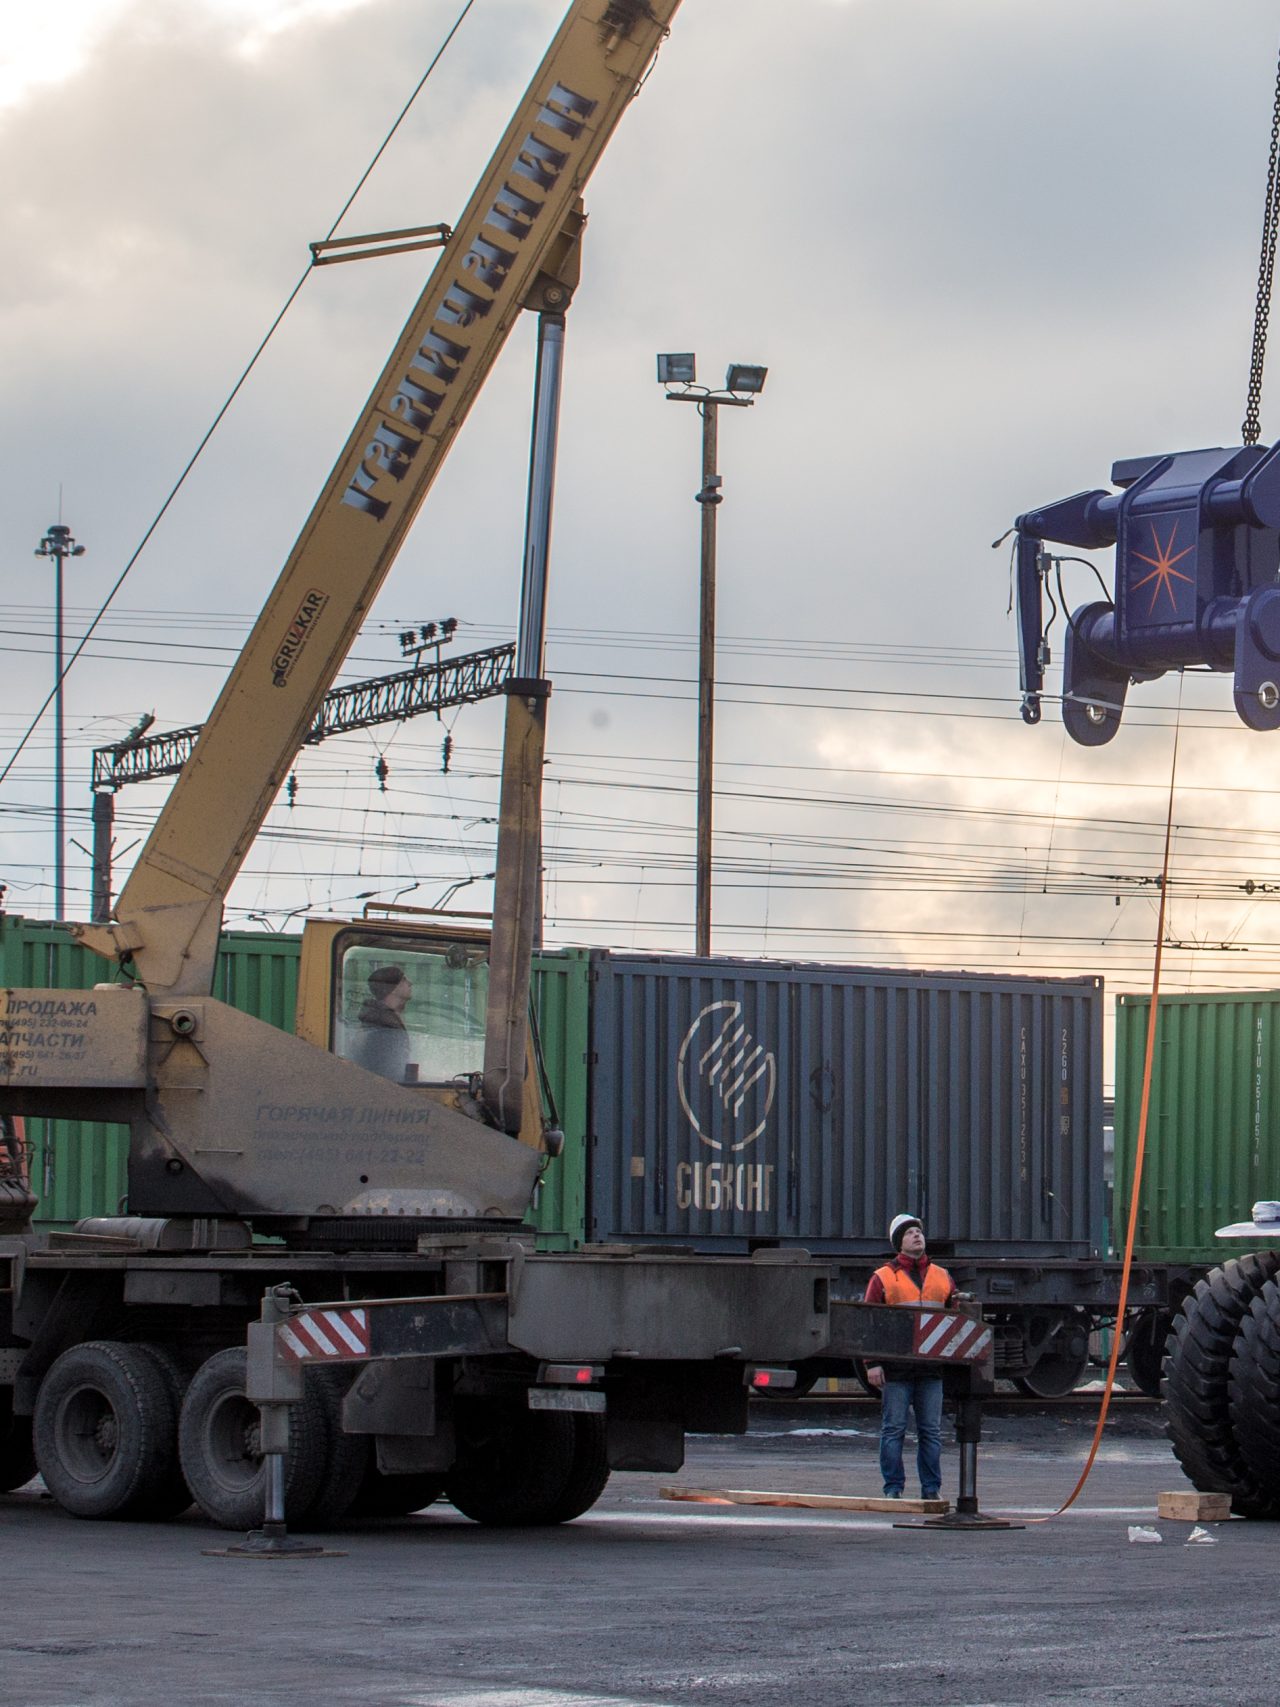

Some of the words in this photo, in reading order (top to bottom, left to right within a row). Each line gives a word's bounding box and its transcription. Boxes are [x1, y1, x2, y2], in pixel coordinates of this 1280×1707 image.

[341, 82, 597, 520] ГАЛИЧАНИН
[275, 592, 323, 670] GRUZKAR
[5, 1000, 97, 1017] ПРОДАЖА
[256, 1104, 356, 1122] ГОРЯЧАЯ
[356, 1106, 432, 1125] ЛИНИЯ
